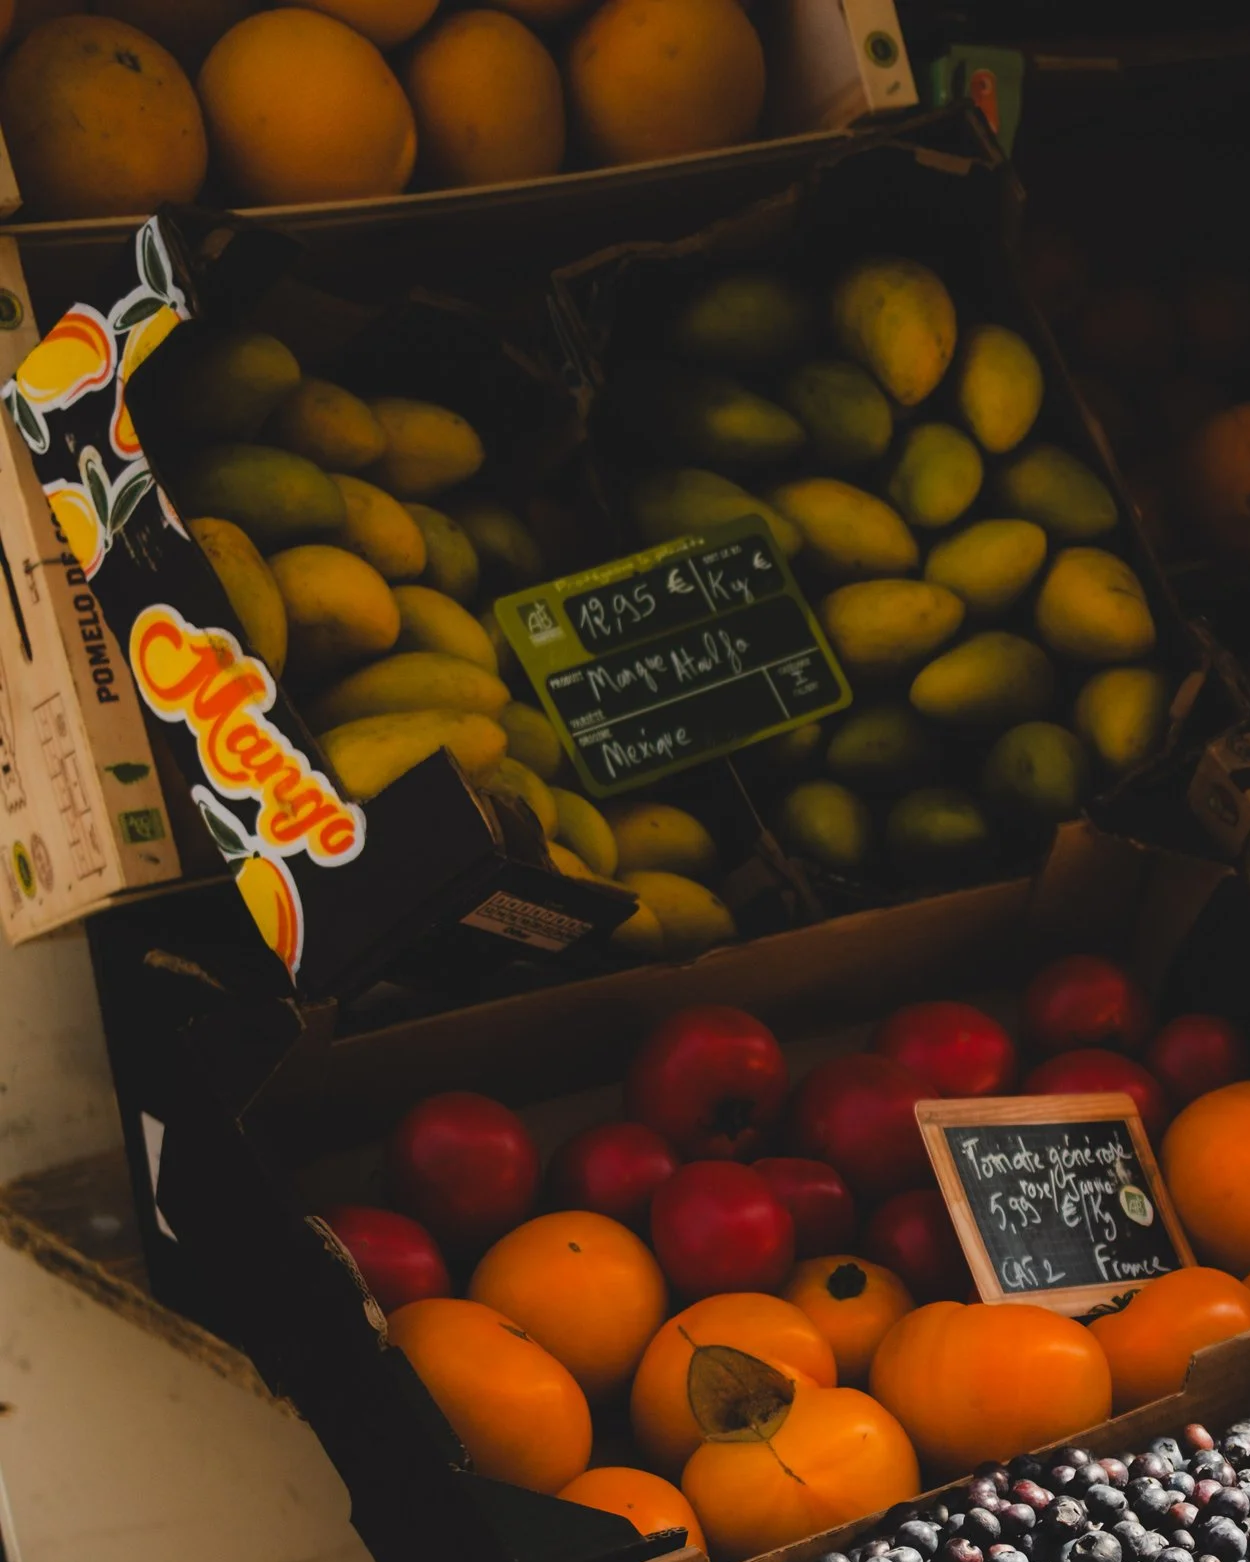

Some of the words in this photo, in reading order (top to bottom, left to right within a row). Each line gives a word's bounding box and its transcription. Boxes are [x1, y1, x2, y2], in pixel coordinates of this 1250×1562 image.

[752, 550, 774, 571] €
[580, 582, 657, 641] 12,95
[665, 566, 696, 595] €
[72, 594, 120, 703] POMELO
[138, 620, 356, 856] Mango
[601, 726, 693, 779] Mexique
[961, 1134, 1046, 1181] Tomate
[989, 1192, 1043, 1235] 5,99
[1002, 1256, 1040, 1290] CAT
[1044, 1258, 1066, 1284] 2
[1094, 1243, 1172, 1283] France
